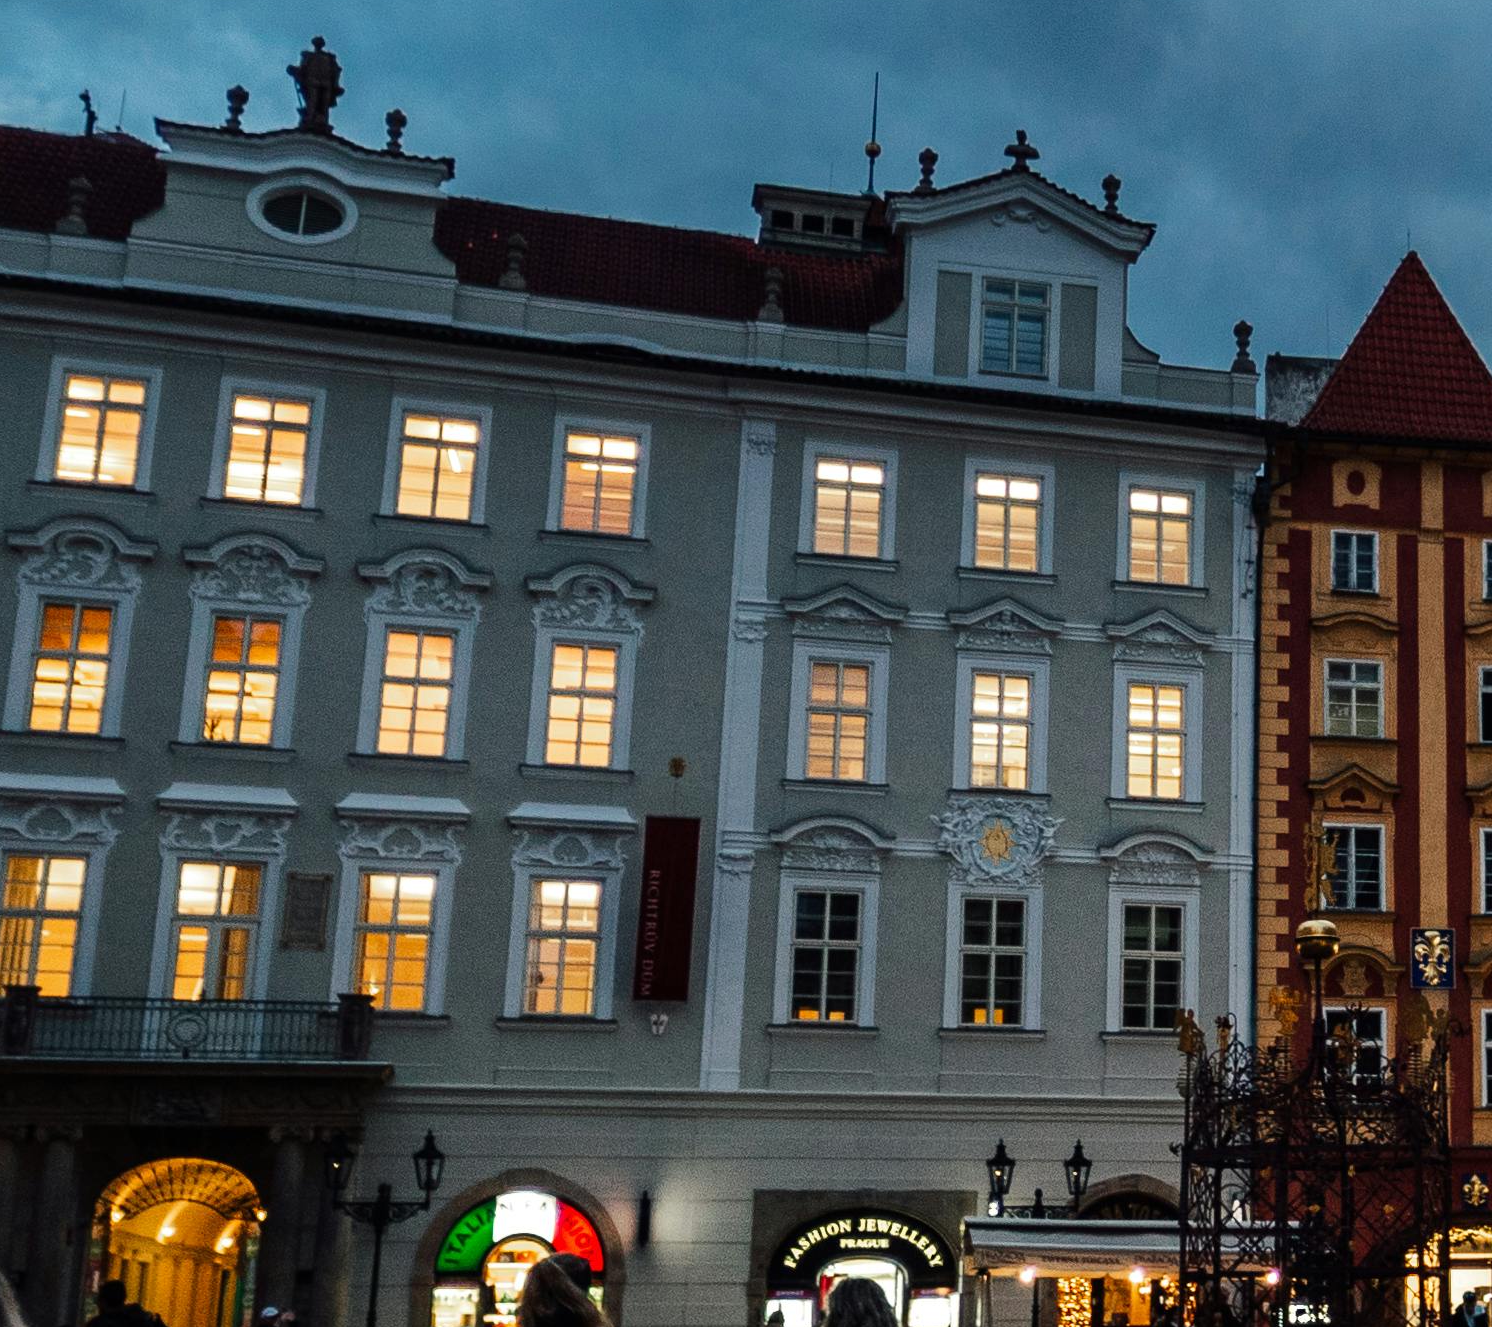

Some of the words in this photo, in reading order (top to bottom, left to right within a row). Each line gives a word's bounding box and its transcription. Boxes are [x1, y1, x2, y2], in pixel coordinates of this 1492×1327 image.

[783, 1219, 852, 1269] FASHION
[858, 1218, 944, 1268] JEWELLERY
[839, 1238, 890, 1249] PRAGUE
